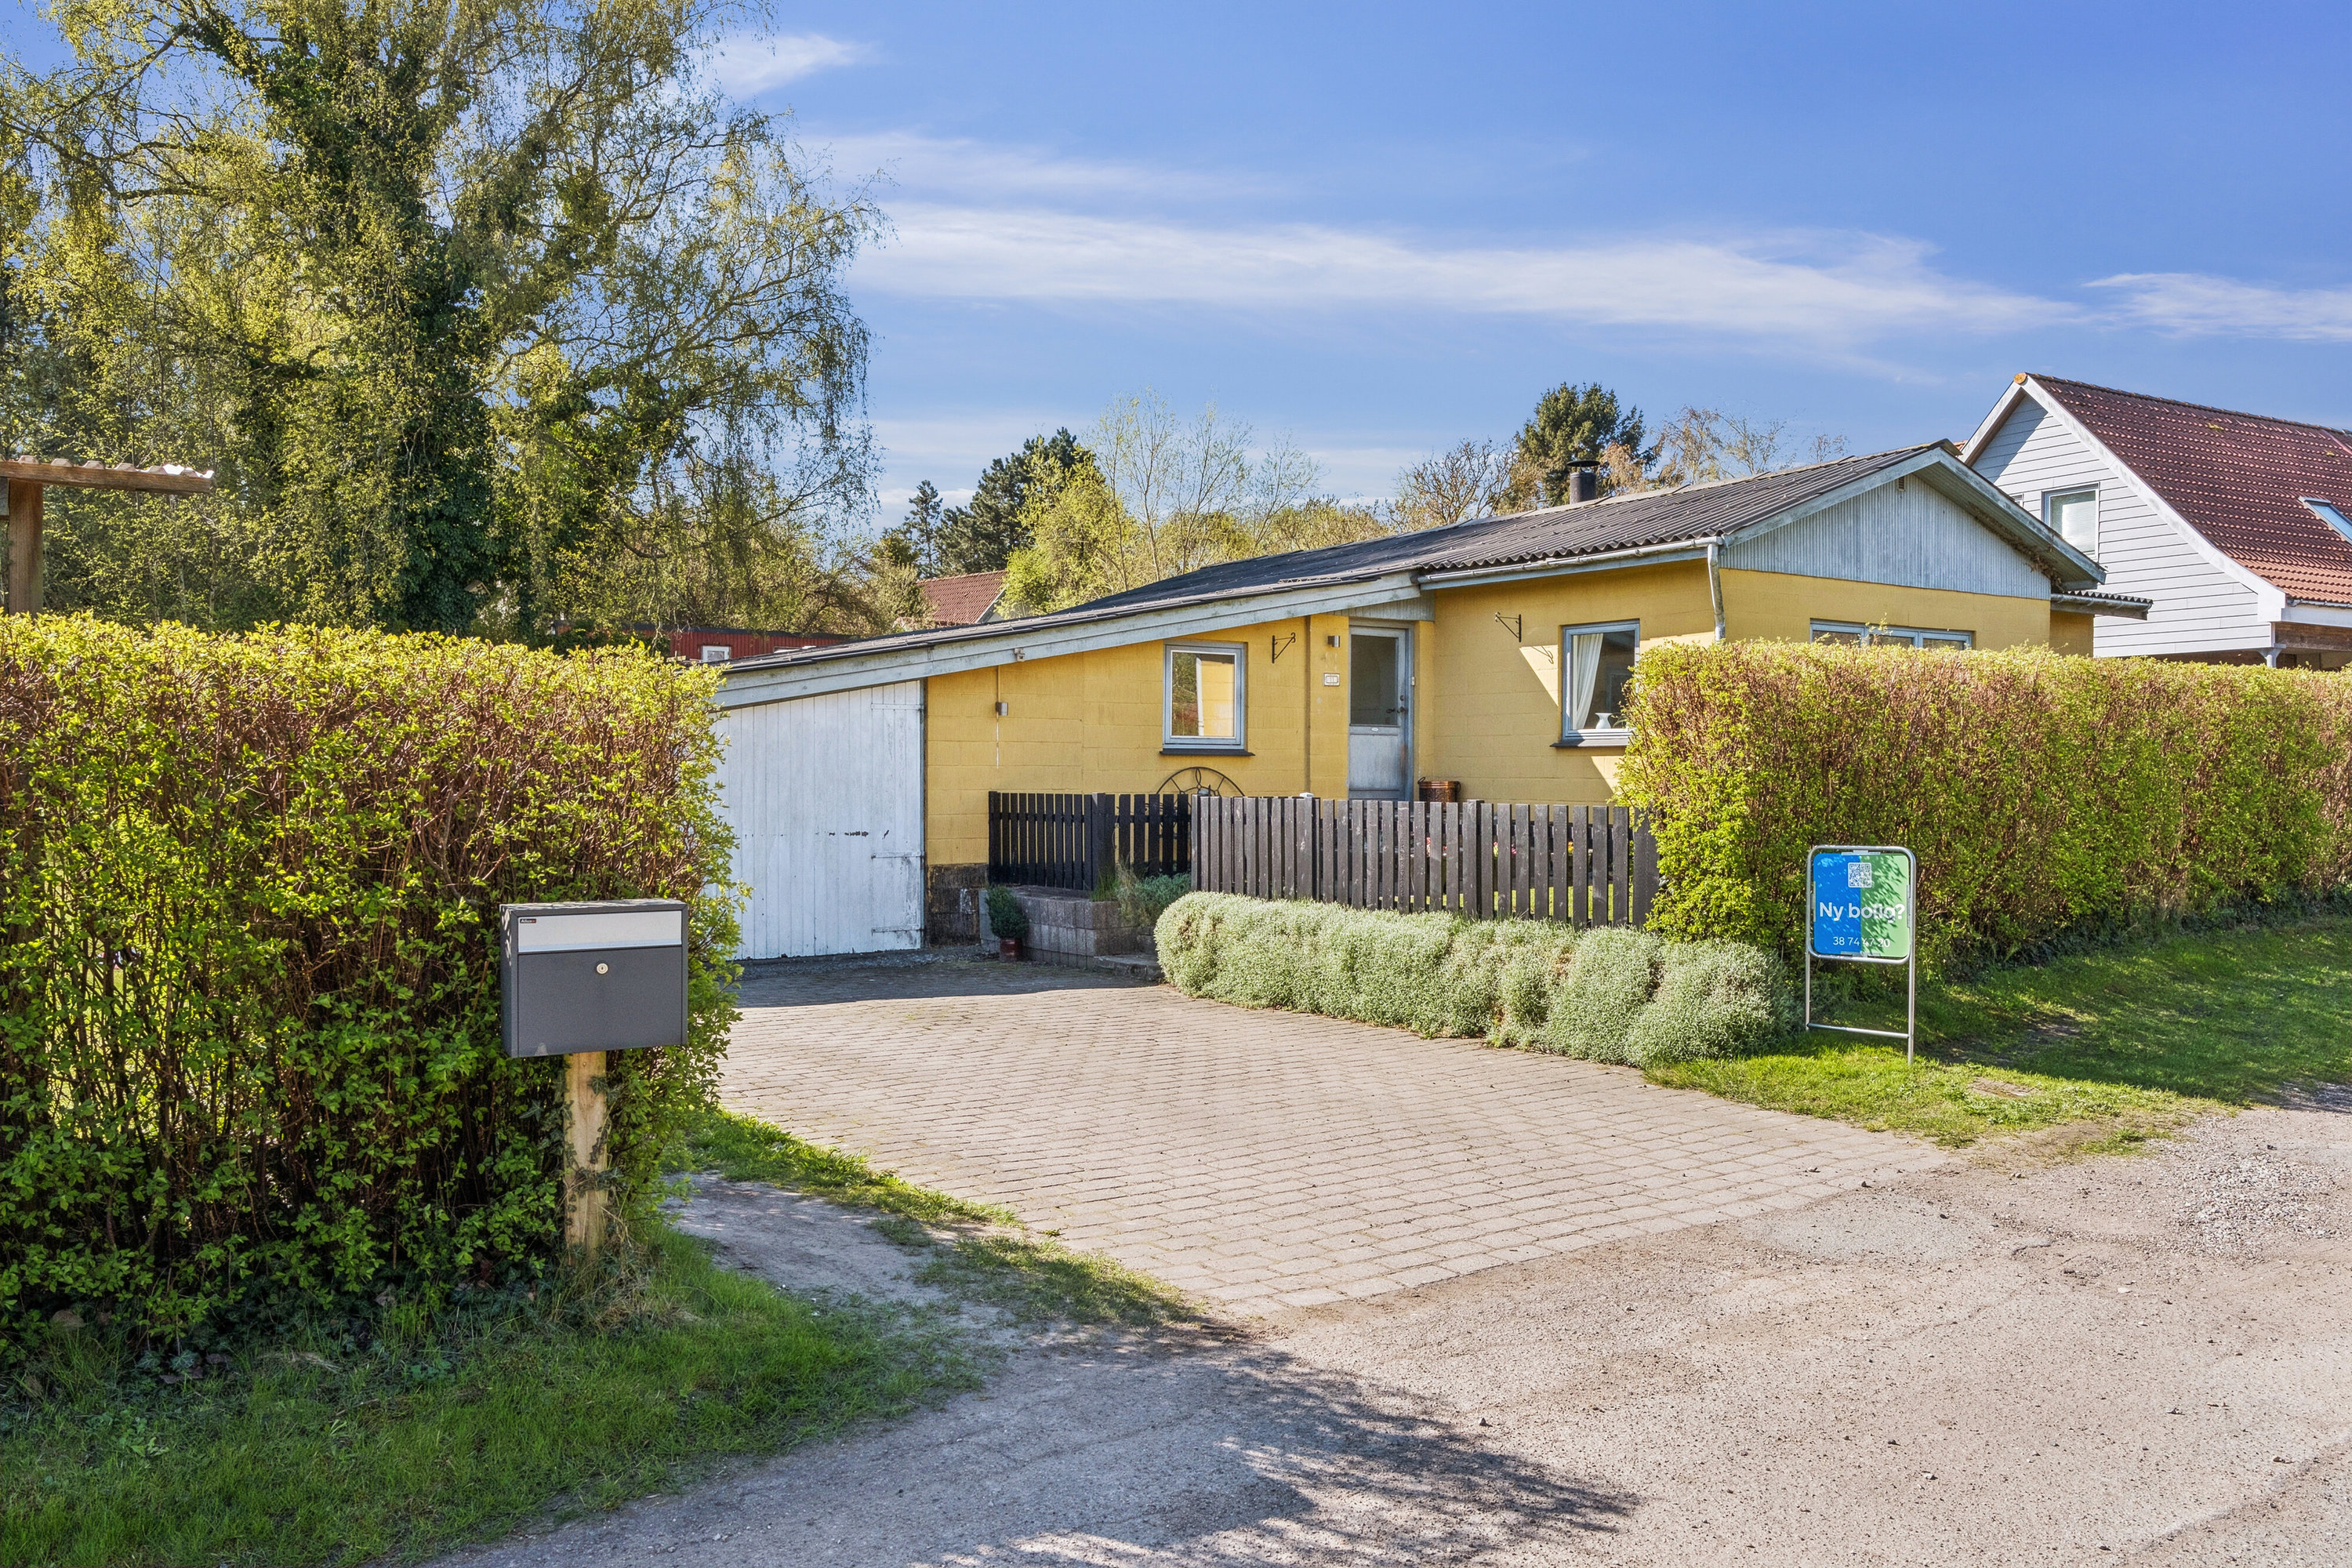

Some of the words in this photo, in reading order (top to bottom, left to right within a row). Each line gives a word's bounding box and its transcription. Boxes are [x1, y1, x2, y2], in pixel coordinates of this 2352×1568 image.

[1820, 902, 1844, 921] Ny
[1849, 902, 1905, 924] bolig?
[1833, 936, 1845, 946] 38
[1847, 937, 1860, 946] 74
[1862, 938, 1875, 947] 47
[1878, 938, 1890, 948] 20
